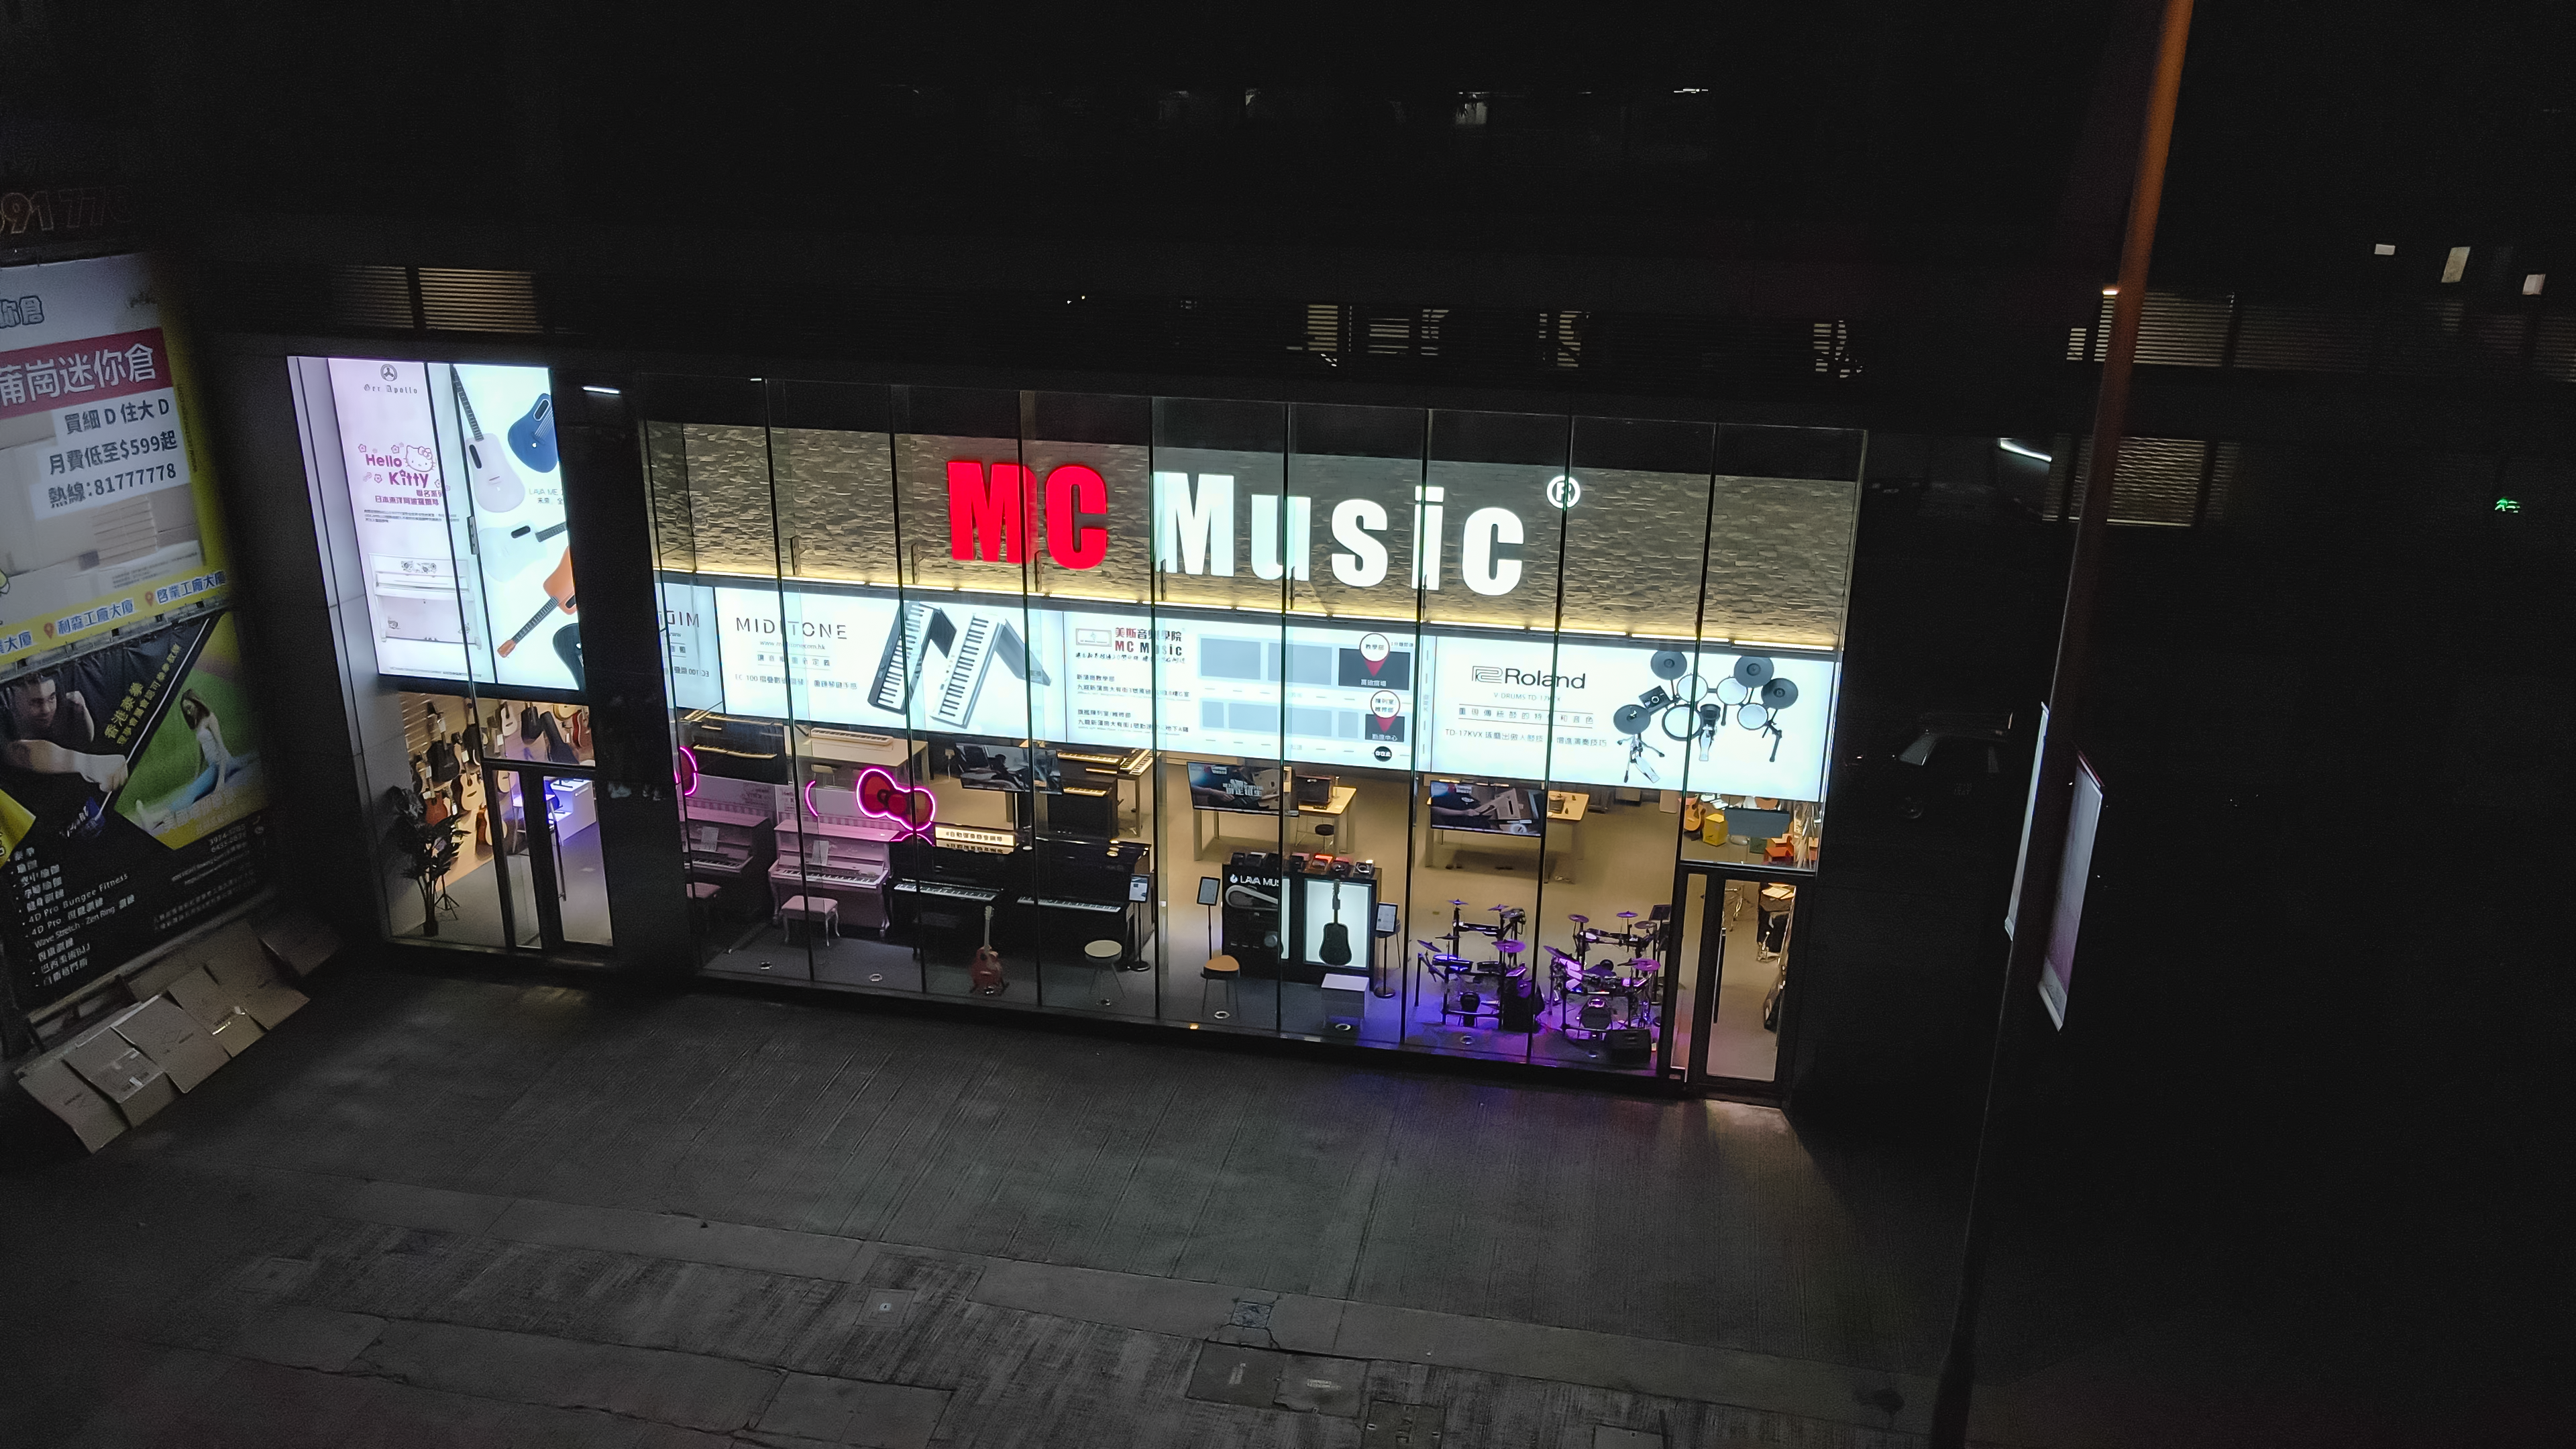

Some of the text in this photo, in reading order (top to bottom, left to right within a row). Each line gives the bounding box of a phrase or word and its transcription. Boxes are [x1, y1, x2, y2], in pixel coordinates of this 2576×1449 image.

[0, 192, 54, 234] 91
[386, 385, 418, 394] Apollo
[65, 398, 170, 435] 買細 D 住大 D
[50, 430, 178, 476] 月費低至$599起
[366, 453, 402, 468] Hello
[388, 471, 429, 488] Kitty
[947, 460, 1108, 570] MC
[1153, 472, 1524, 596] Music
[1115, 641, 1134, 653] MC
[1505, 667, 1586, 689] Roland
[1240, 875, 1261, 885] LAVA
[29, 873, 129, 923] 4D Pro Bungee Fitness
[32, 925, 44, 936] 4D
[48, 918, 62, 929] Pro
[34, 934, 55, 949] Wave
[55, 922, 81, 938] Stretch
